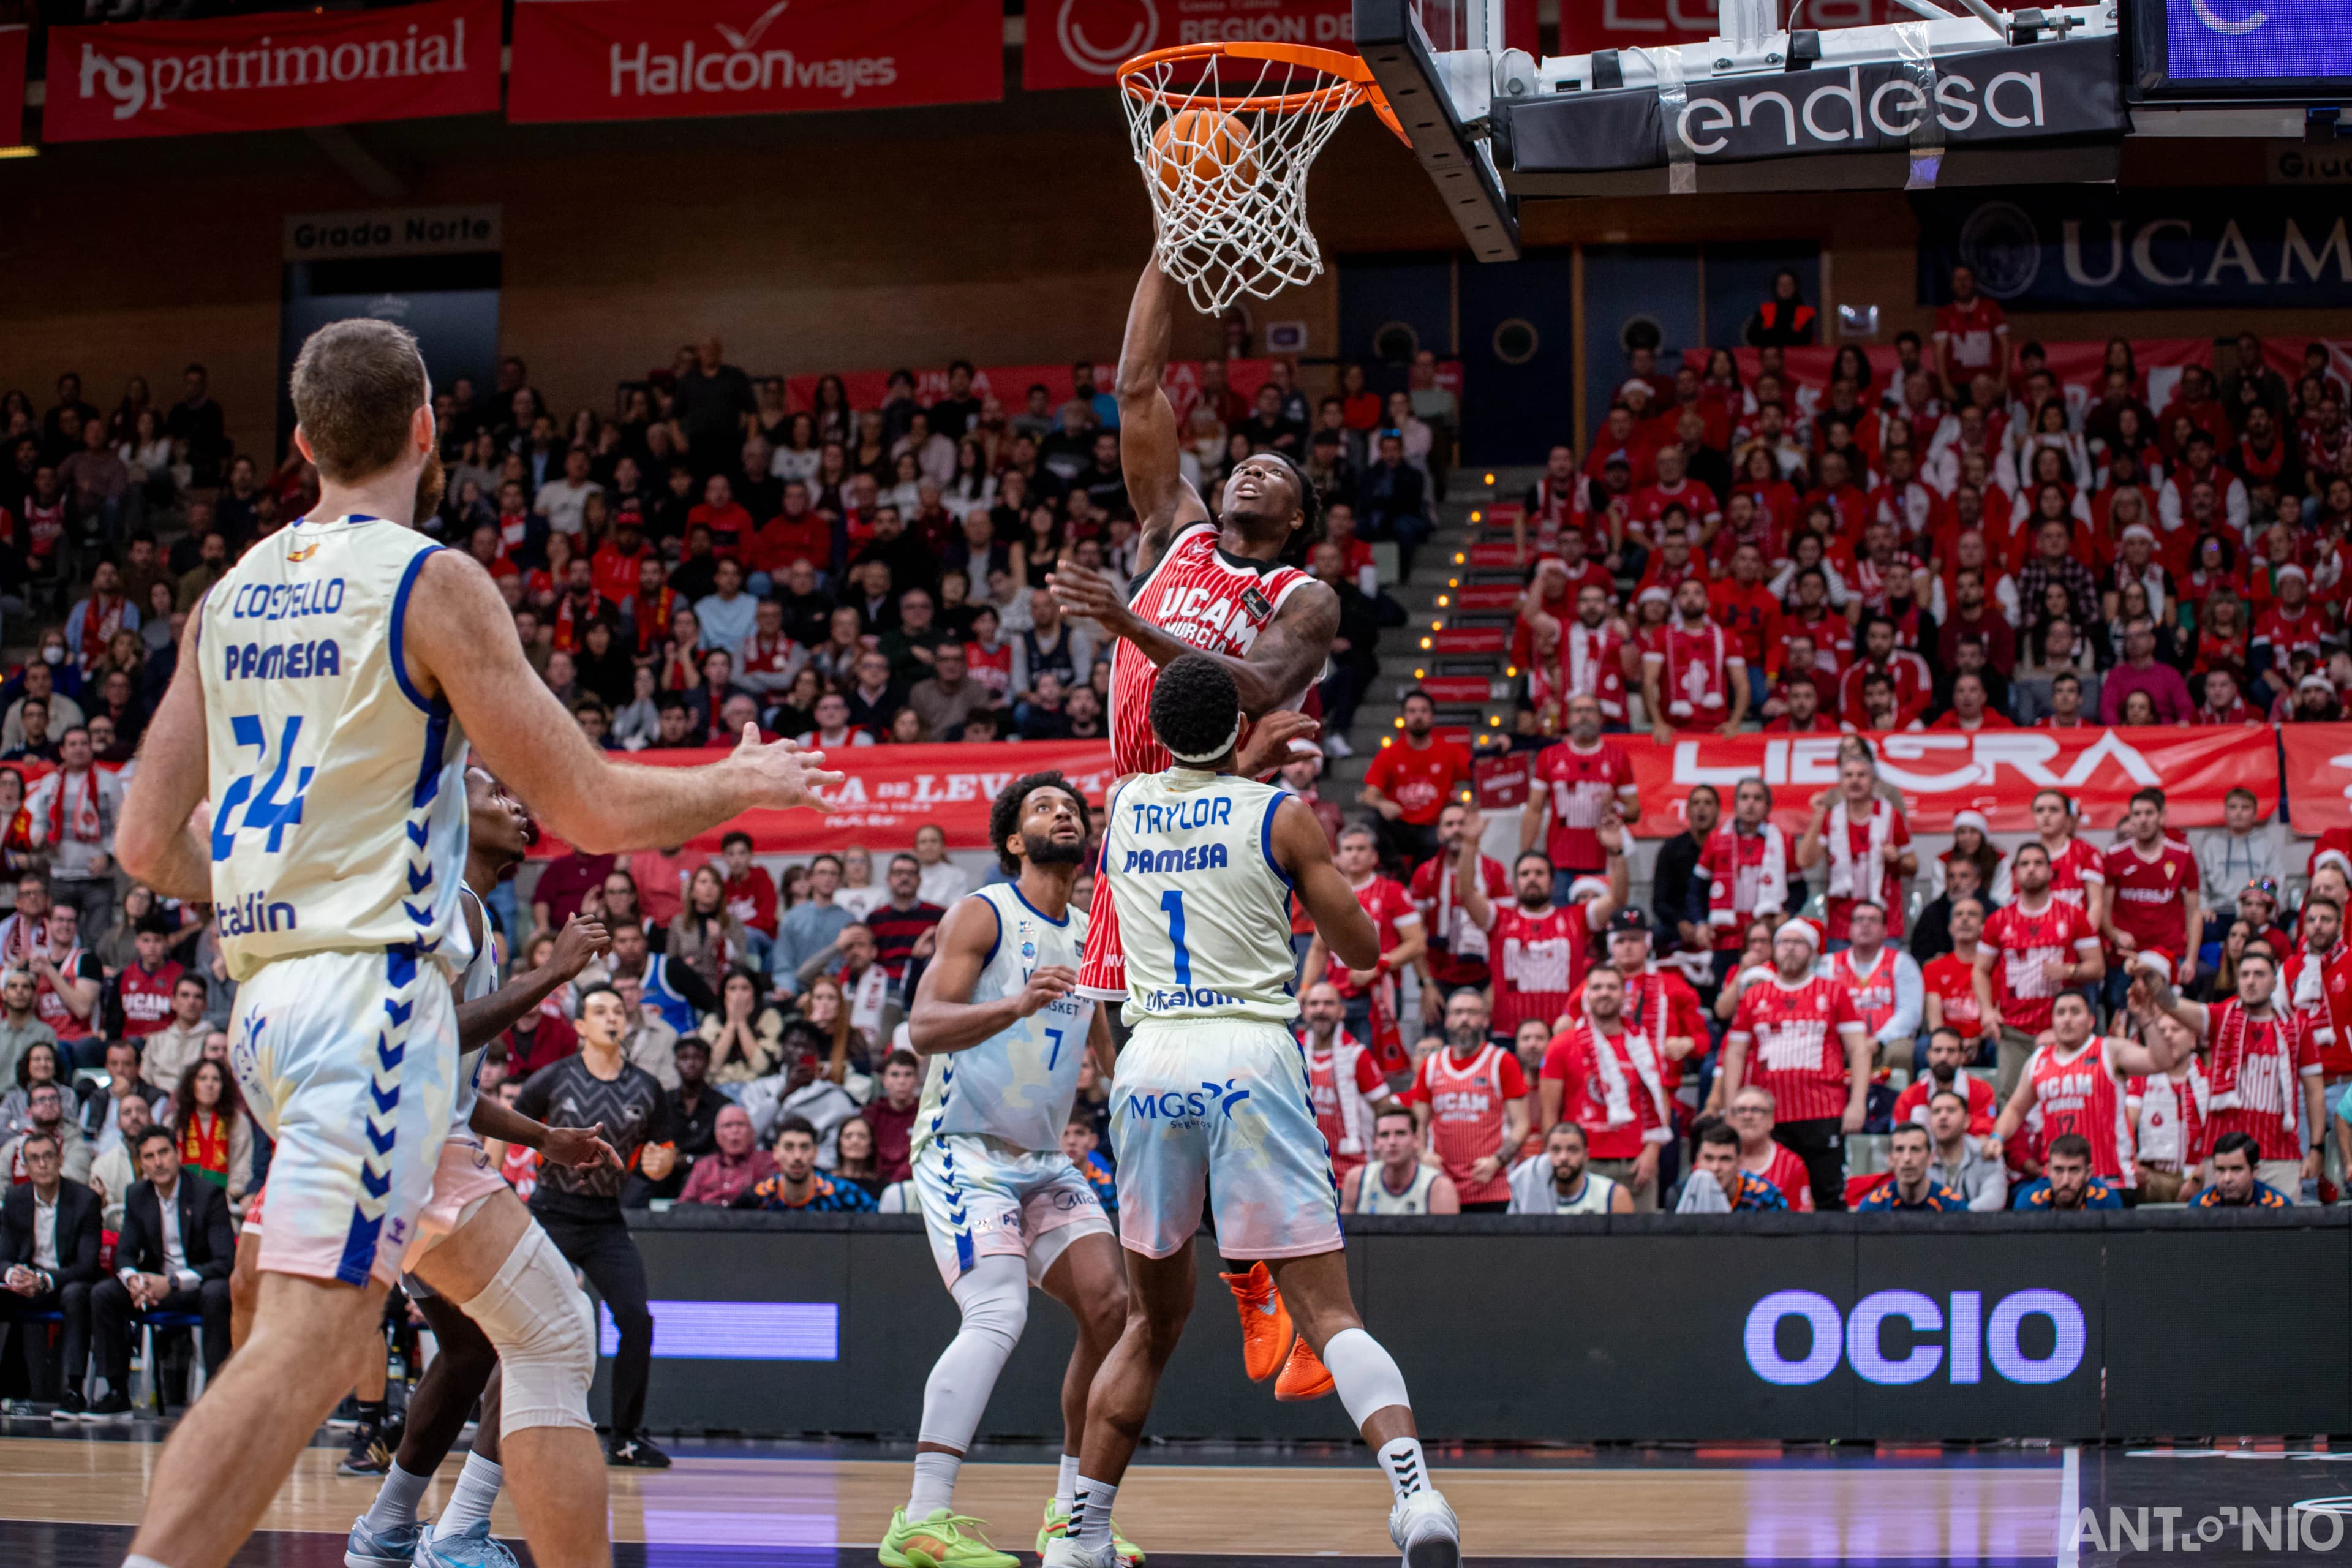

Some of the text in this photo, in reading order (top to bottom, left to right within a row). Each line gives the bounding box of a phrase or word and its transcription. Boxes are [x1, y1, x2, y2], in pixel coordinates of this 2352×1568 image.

[149, 18, 468, 111] patrimonial
[1677, 66, 2045, 154] endesa
[295, 216, 490, 249] Grada Norte
[2059, 215, 2352, 288] UCAM
[233, 578, 345, 620] COSTELLO
[1158, 586, 1260, 657] UCAM
[1164, 620, 1229, 655] MURCIA
[225, 639, 341, 681] PAMESA
[211, 714, 315, 862] 24
[1133, 796, 1232, 834] TAYLOR
[1123, 843, 1228, 874] PAMESA
[1160, 890, 1191, 987] 1
[1044, 1000, 1080, 1017] ASKET
[1044, 1028, 1063, 1071] 7
[1130, 1092, 1206, 1119] MGS
[1170, 1120, 1212, 1130] Seguros
[1743, 1288, 2087, 1385] OCIO
